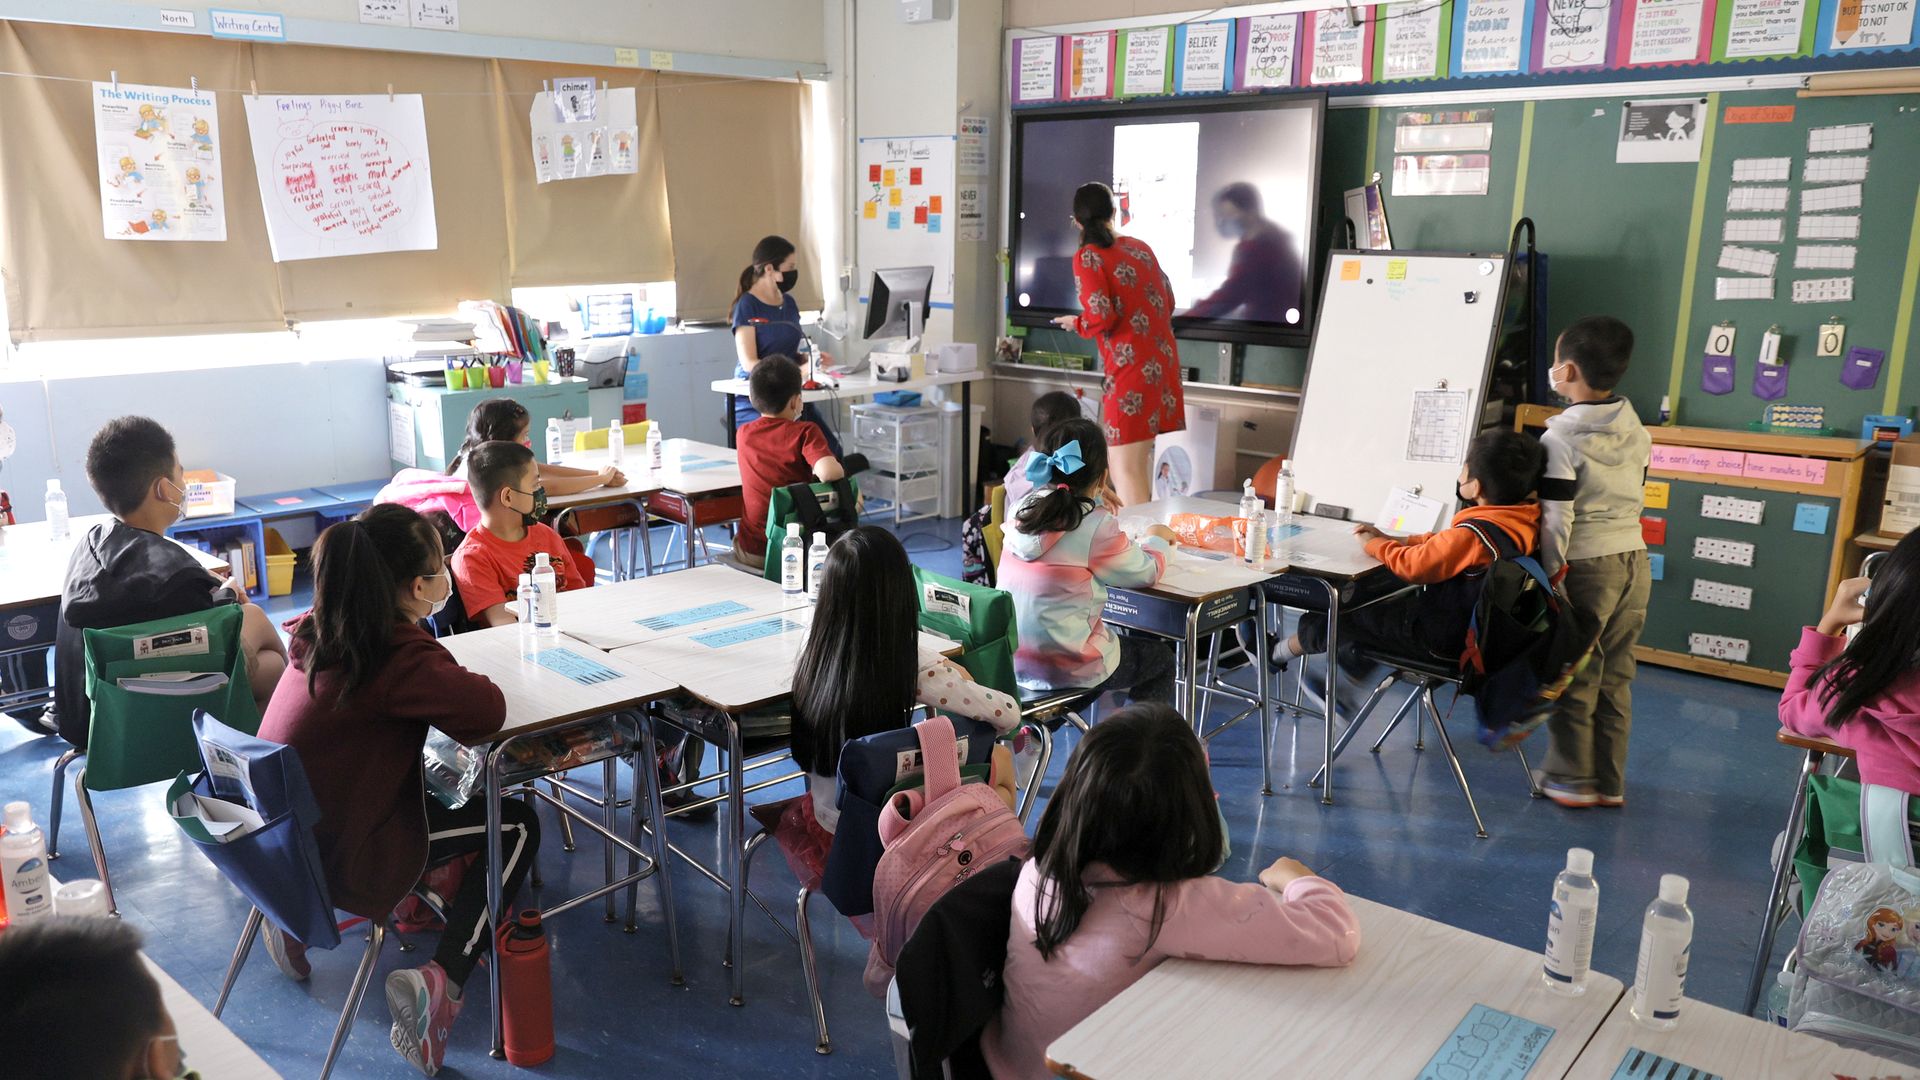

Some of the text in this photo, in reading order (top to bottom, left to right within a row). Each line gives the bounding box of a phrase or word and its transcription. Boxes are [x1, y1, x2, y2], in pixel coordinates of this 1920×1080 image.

[1470, 5, 1493, 17] It's
[1842, 2, 1907, 15] BUT IT'S NOT OK
[162, 14, 188, 23] North
[1493, 17, 1509, 30] DAY
[1784, 17, 1796, 25] you
[1859, 16, 1888, 27] TO NOT
[215, 16, 279, 33] Writing Center
[1188, 36, 1218, 48] BELIEVE
[1251, 36, 1268, 44] are
[1467, 37, 1479, 46] to
[1480, 35, 1507, 44] have
[1859, 31, 1886, 44] try.
[1147, 40, 1159, 48] you
[1252, 45, 1288, 54] that you
[1338, 42, 1357, 50] when
[1136, 63, 1148, 71] you
[101, 89, 211, 105] The Writing Process
[276, 99, 342, 115] Feelings Piggy
[1653, 452, 1665, 463] We
[1669, 453, 1710, 469] earn/keep
[1717, 456, 1742, 470] choice
[1747, 462, 1764, 471] time
[1770, 464, 1801, 476] minutes
[1206, 602, 1238, 618] HAMMERMILL
[1709, 647, 1726, 656] up
